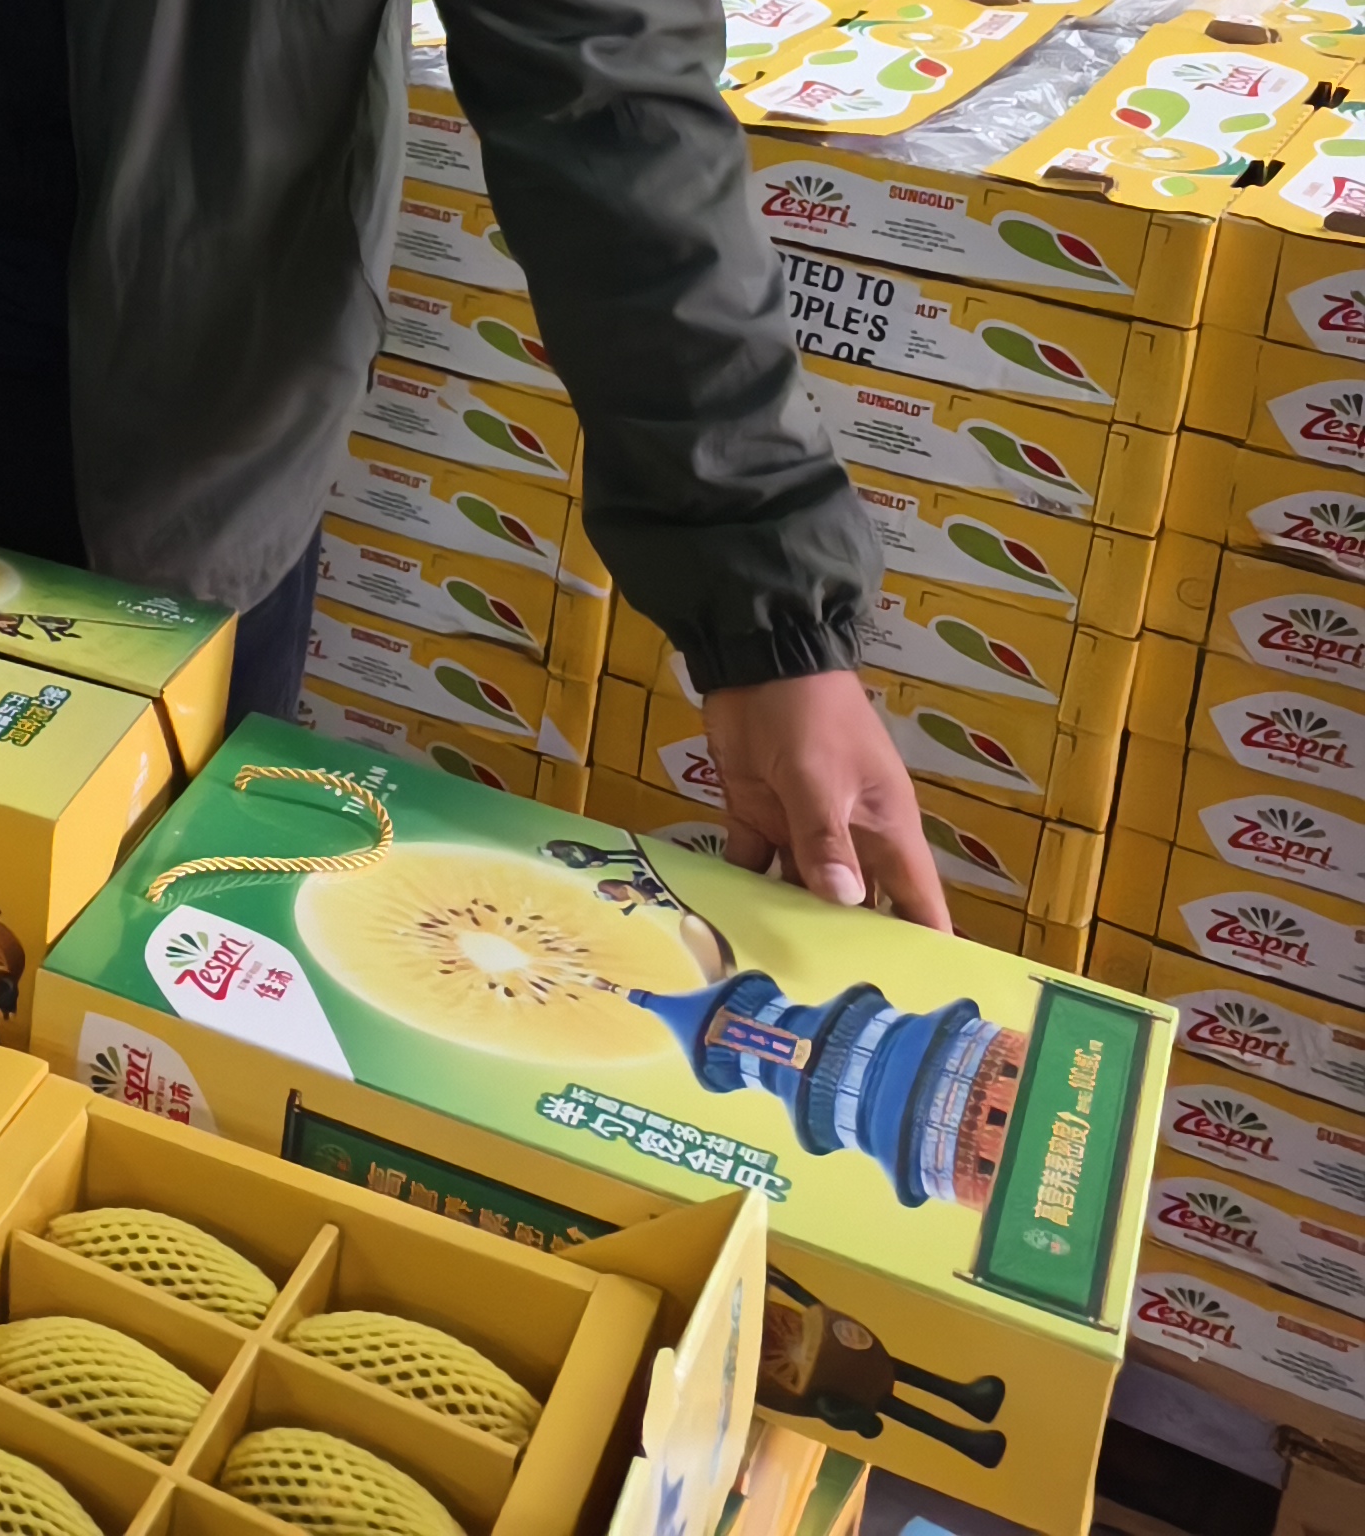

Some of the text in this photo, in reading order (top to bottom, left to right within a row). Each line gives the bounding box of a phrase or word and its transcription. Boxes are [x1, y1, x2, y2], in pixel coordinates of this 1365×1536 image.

[761, 183, 854, 228] Zespri
[856, 272, 895, 307] TO
[1241, 711, 1354, 768] Zespri
[1227, 814, 1337, 871] Zespri
[174, 932, 254, 1001] Zespri
[1206, 908, 1312, 967] Zespri
[1186, 1007, 1293, 1066] Zespri
[124, 1043, 152, 1111] spri
[1173, 1099, 1277, 1162] Zespri
[1158, 1192, 1261, 1254] Zespri
[1138, 1288, 1240, 1350] Zespri
